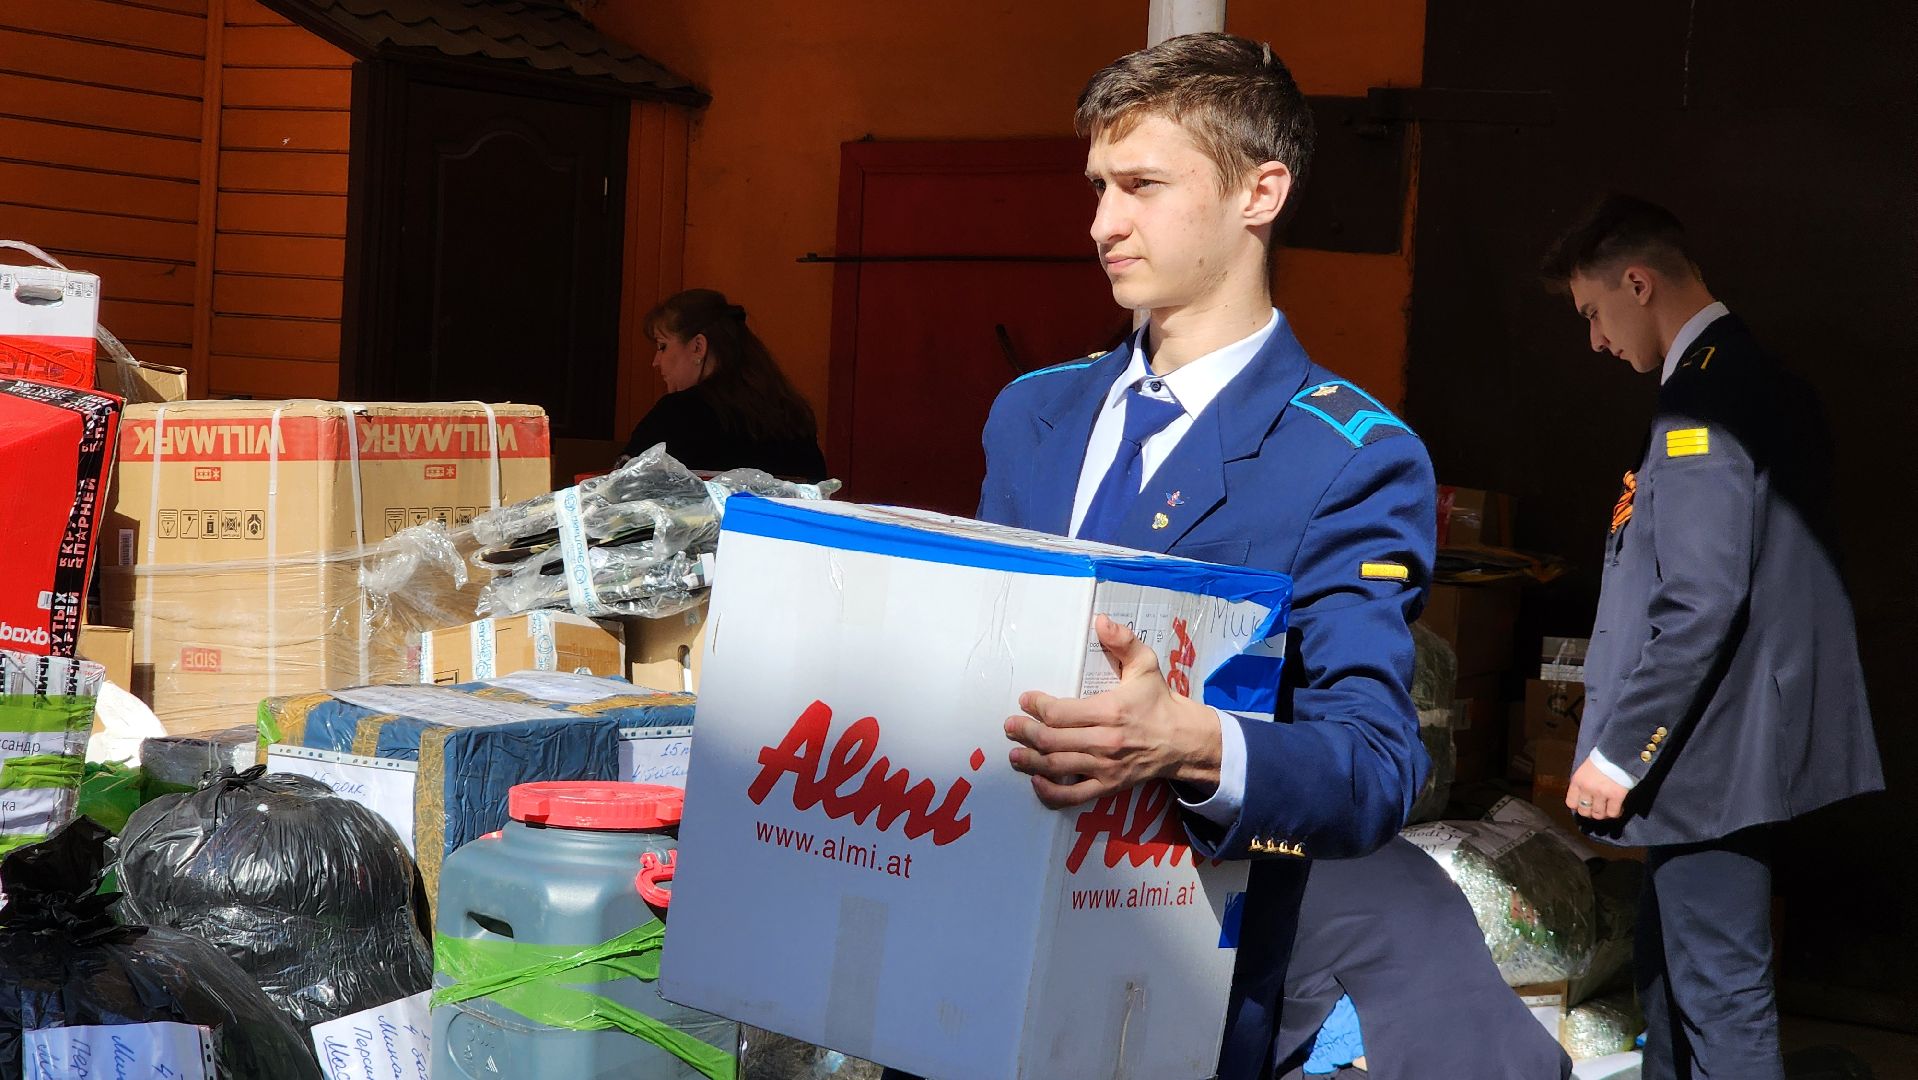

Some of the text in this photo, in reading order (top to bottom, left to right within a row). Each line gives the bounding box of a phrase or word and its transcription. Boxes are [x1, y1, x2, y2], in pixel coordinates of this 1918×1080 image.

[361, 423, 518, 453] WILLMARK
[0, 622, 50, 645] boxb
[51, 592, 67, 656] РУТЫХ
[184, 652, 217, 669] SIDE
[748, 700, 985, 846] Almi
[756, 822, 913, 879] www.almi.at
[1072, 881, 1196, 910] www.almi.at
[353, 1026, 376, 1080] Перси
